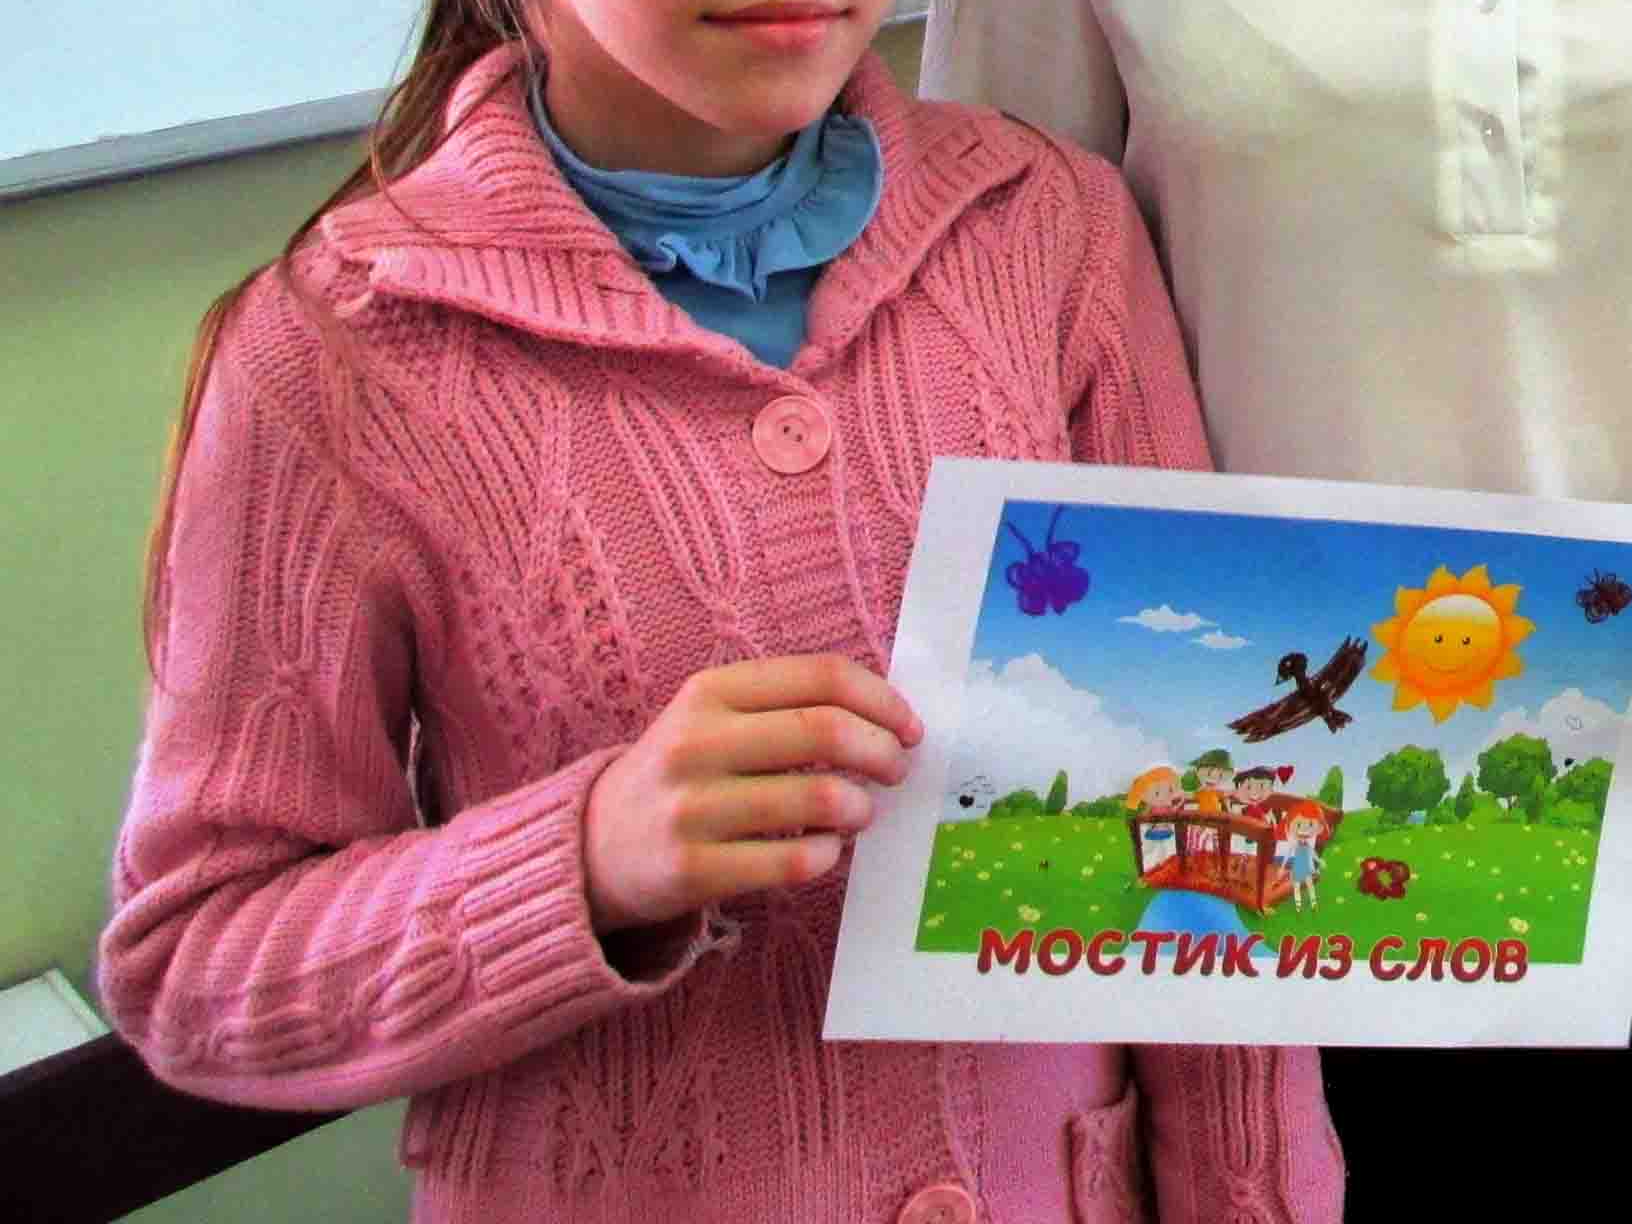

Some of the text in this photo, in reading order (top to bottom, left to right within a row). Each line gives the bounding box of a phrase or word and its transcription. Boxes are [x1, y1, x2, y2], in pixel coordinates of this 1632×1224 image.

[975, 926, 1530, 984] МОСТИК ИЗ СЛОВ
